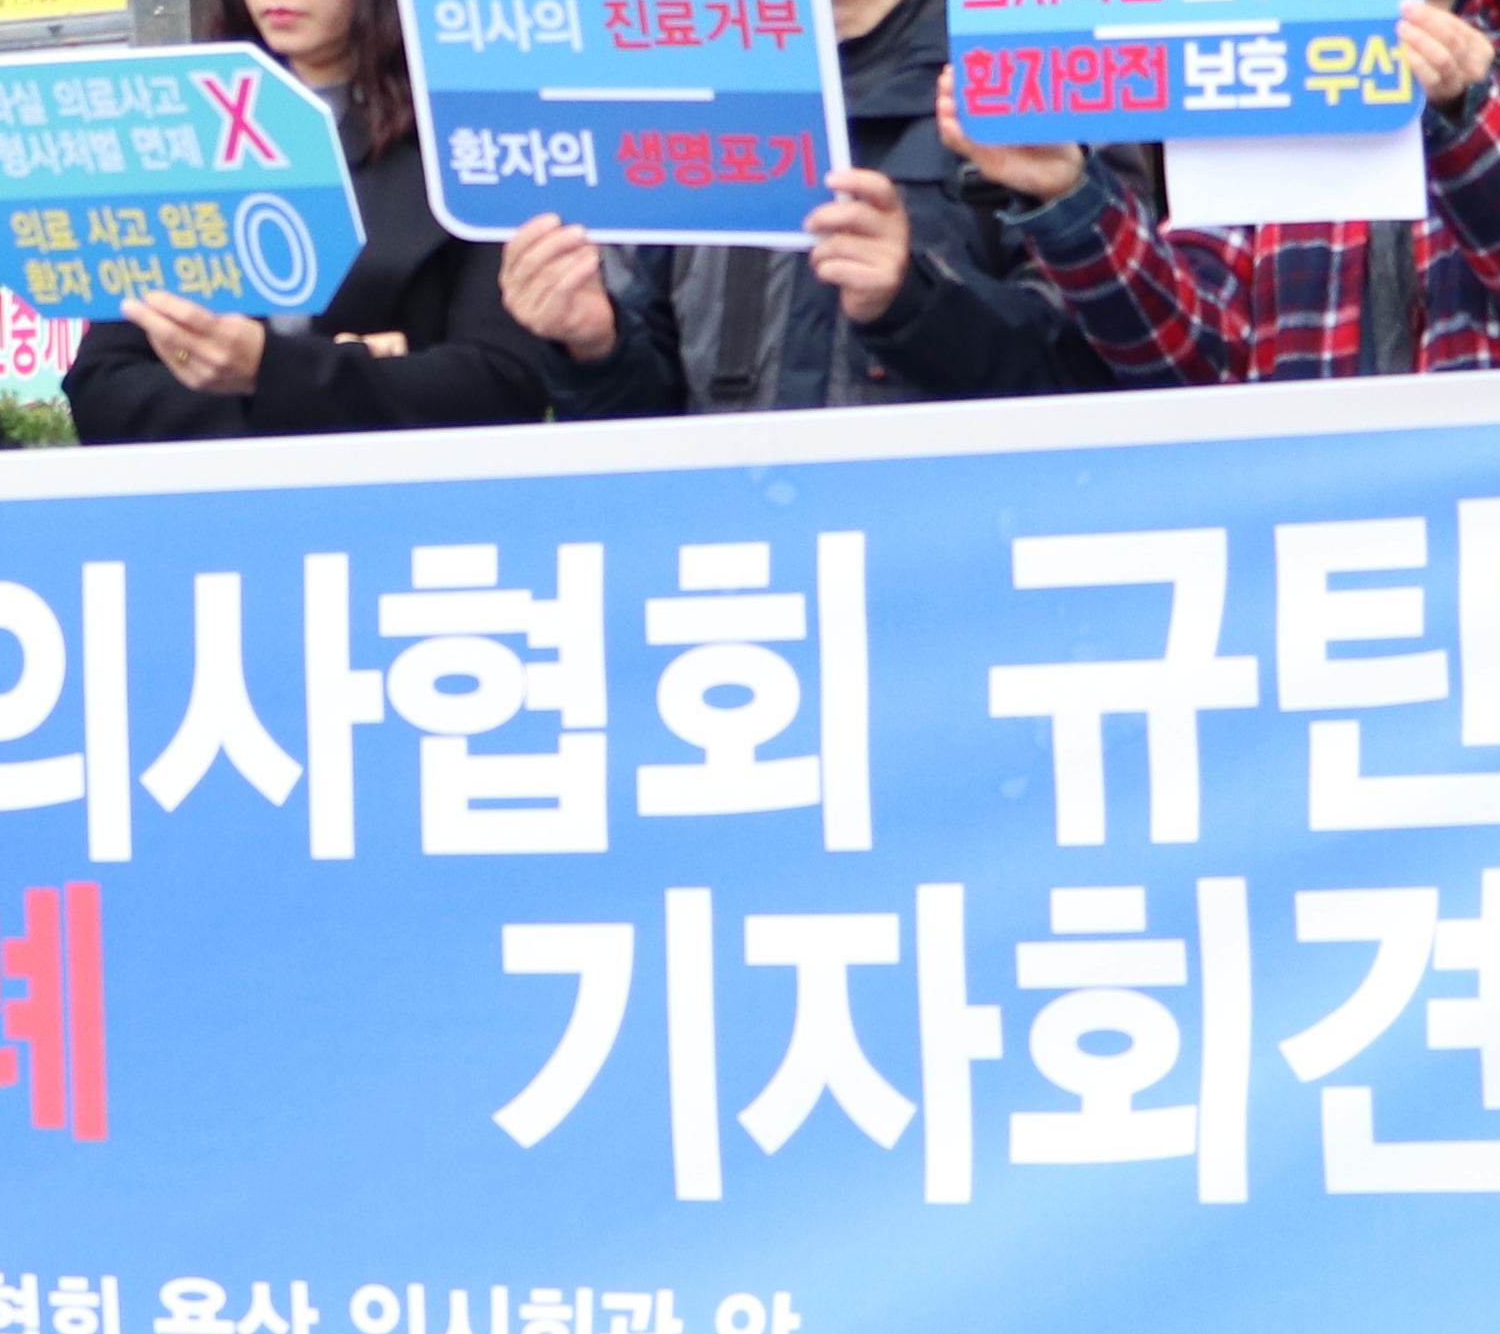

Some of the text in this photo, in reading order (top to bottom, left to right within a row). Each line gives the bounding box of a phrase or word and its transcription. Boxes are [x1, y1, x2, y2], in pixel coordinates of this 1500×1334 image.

[53, 72, 189, 121] 의료사고
[962, 34, 1413, 117] 환자안전 보호 우선
[129, 123, 204, 170] 면제
[448, 127, 818, 188] 환자의 생명포기
[10, 208, 80, 253] 의료
[87, 205, 154, 249] 사고
[159, 201, 230, 249] 입증
[24, 253, 244, 305] 환자 아닌 의사
